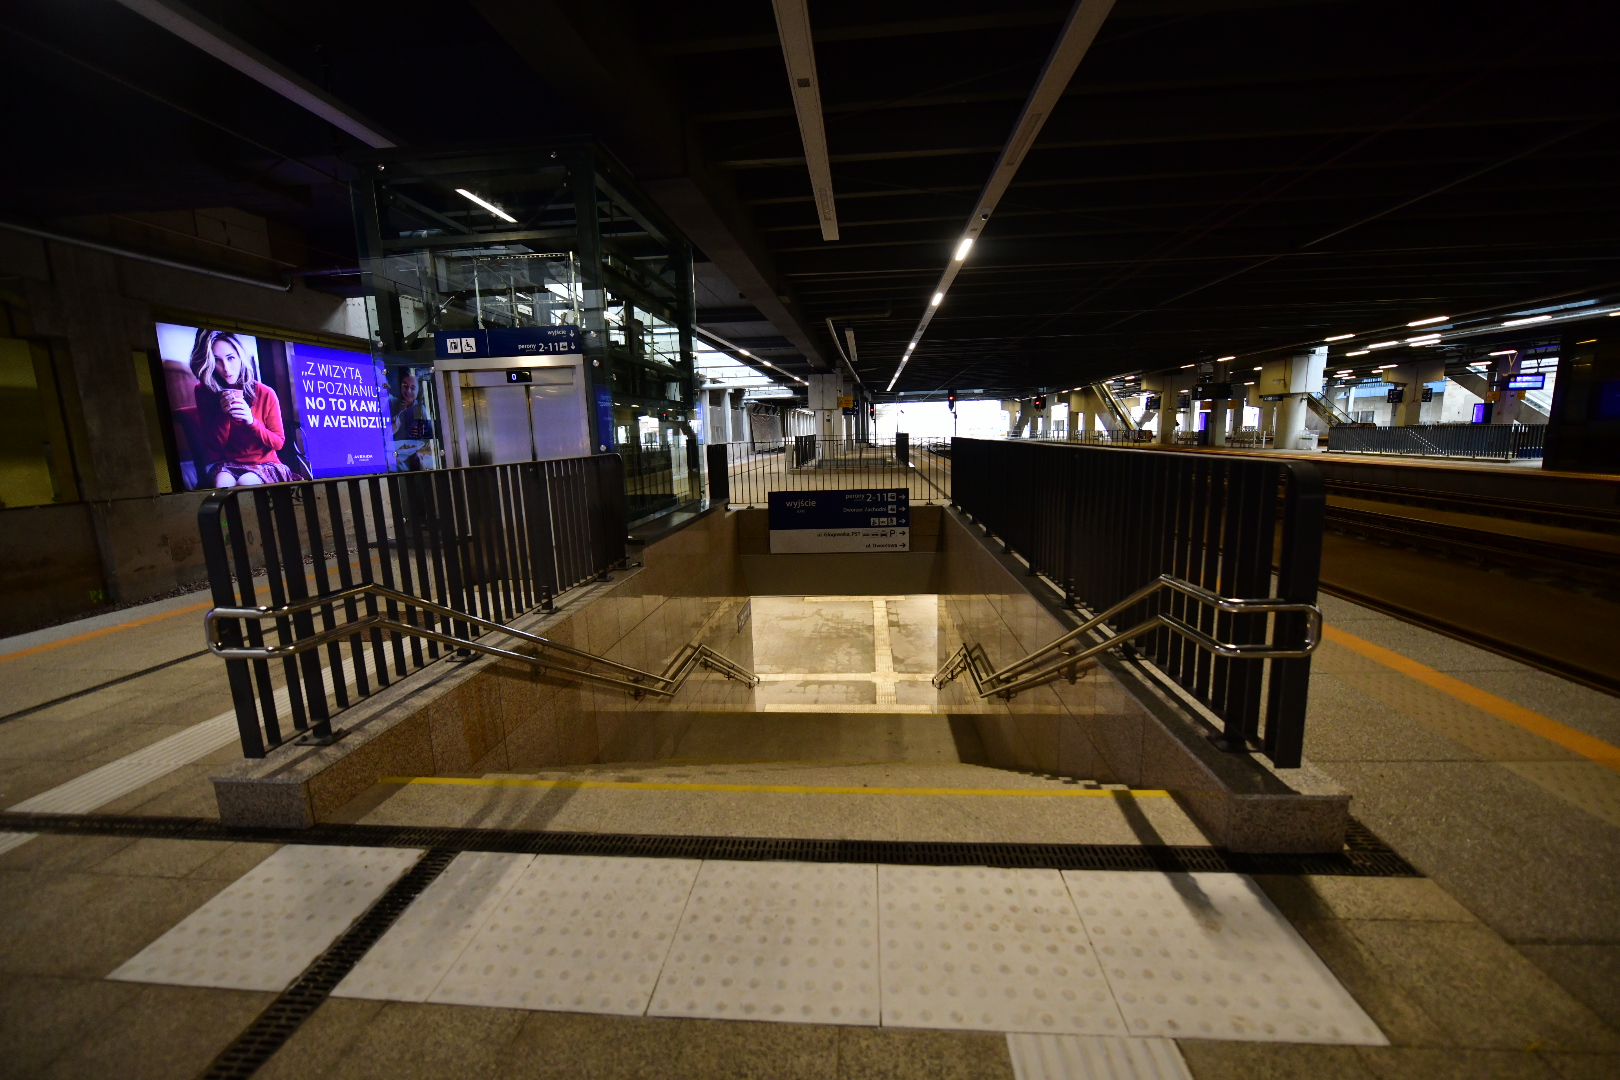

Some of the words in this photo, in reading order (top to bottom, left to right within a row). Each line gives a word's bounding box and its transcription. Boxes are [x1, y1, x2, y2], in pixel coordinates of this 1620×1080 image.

[538, 343, 559, 352] 2-11
[317, 363, 363, 384] WIZYTĄ
[302, 379, 314, 393] W
[305, 396, 326, 411] NO
[328, 397, 347, 411] TO
[307, 414, 320, 428] W
[785, 498, 817, 509] wyjście
[866, 492, 887, 502] 2-11
